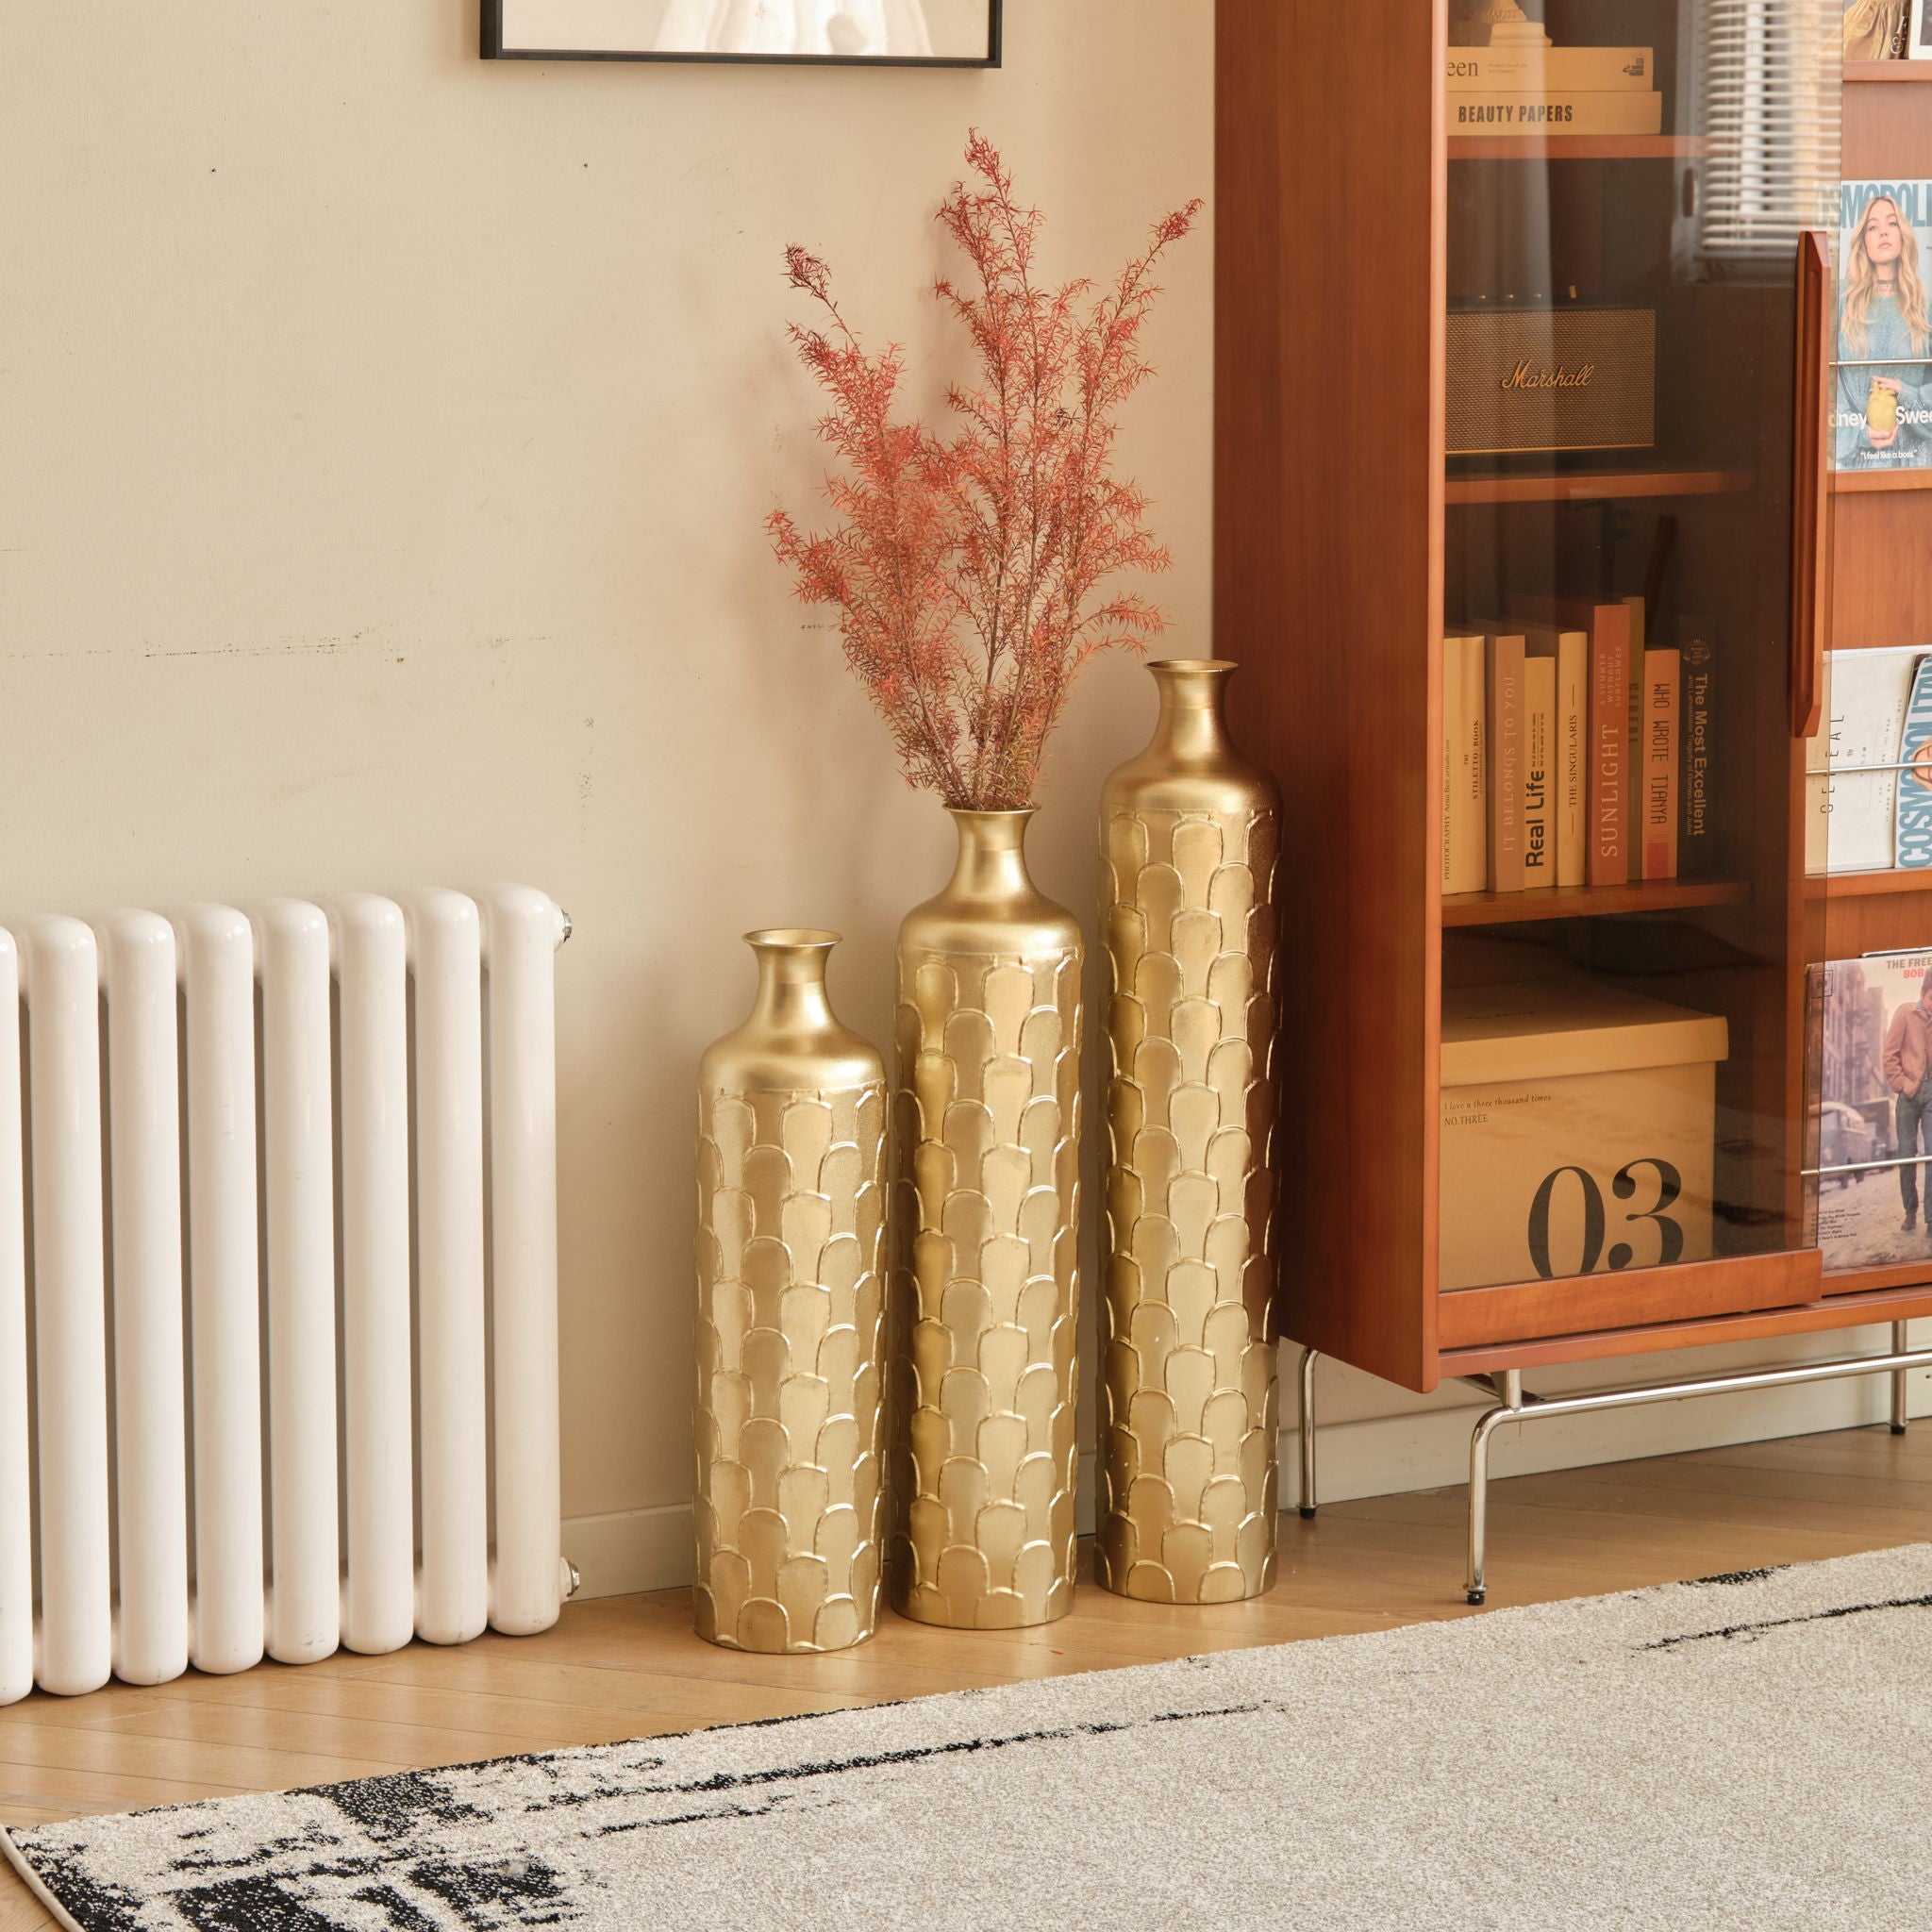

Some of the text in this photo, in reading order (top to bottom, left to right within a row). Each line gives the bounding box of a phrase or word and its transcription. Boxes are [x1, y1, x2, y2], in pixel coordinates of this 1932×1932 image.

[1457, 105, 1574, 123] BEAUTY PAPERS
[1501, 358, 1595, 390] Marshall
[1867, 451, 1880, 460] feel
[1503, 717, 1517, 740] TO
[1650, 683, 1670, 824] WHO WROTE TIANYA
[1692, 673, 1707, 837] The Most Excellent
[1503, 746, 1517, 825] BELONGS
[1569, 714, 1577, 808] THE SINGULARIS
[1601, 724, 1619, 858] SUNLIGHT
[1524, 770, 1545, 868] Real Life
[1886, 958, 1906, 970] THE
[1903, 968, 1924, 979] BOB
[1449, 1101, 1465, 1110] love
[1474, 1098, 1492, 1108] three
[1494, 1094, 1529, 1107] thousand
[1531, 1094, 1554, 1103] times.
[1527, 1157, 1685, 1278] 03
